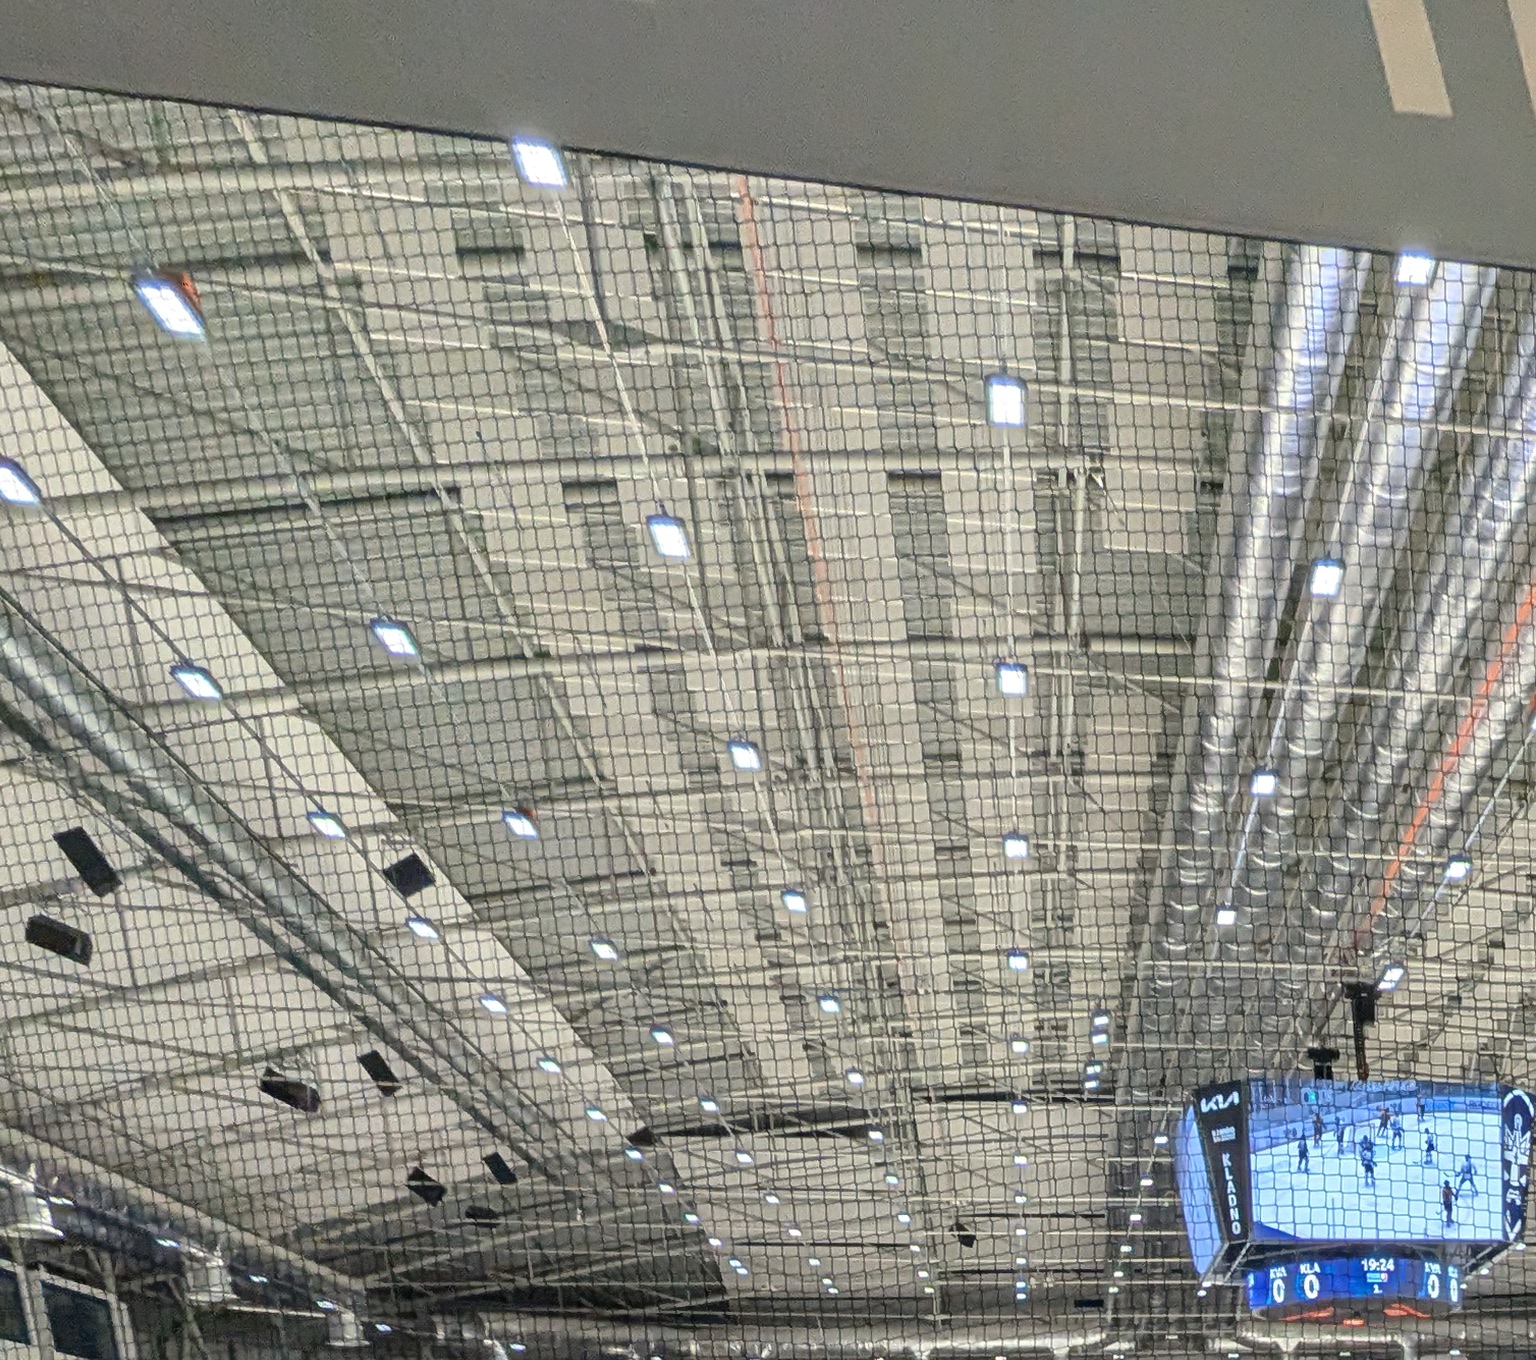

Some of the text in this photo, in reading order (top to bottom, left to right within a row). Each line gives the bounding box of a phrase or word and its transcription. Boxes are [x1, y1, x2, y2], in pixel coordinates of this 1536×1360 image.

[1222, 1152, 1242, 1235] KLADNO
[1300, 1262, 1321, 1275] KLA
[1361, 1258, 1395, 1272] 19:24
[1272, 1278, 1286, 1304] 0
[1303, 1274, 1320, 1299] 0
[1427, 1274, 1440, 1298] 0
